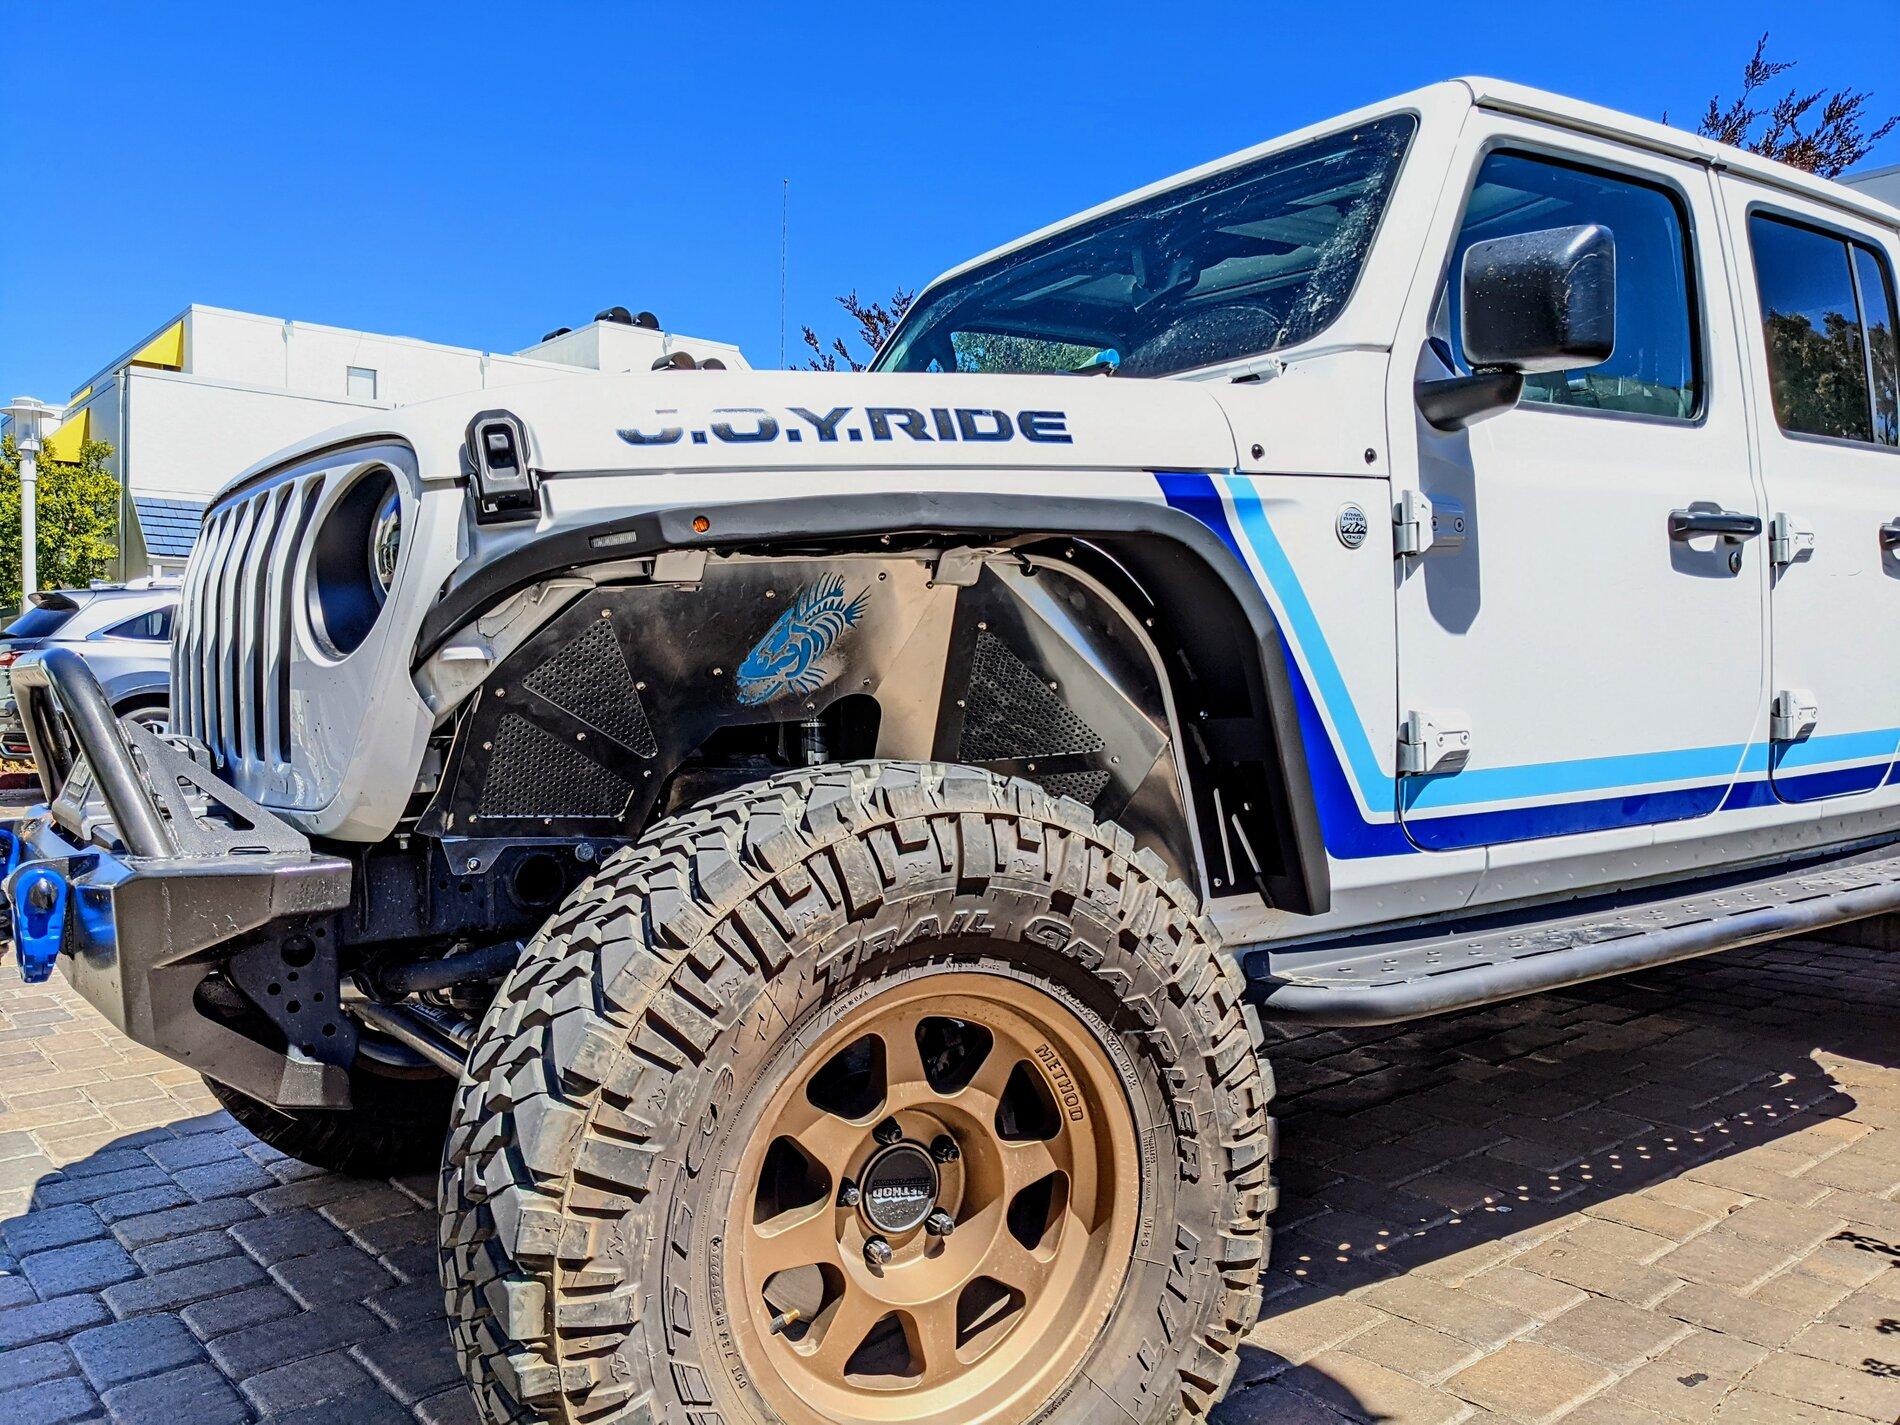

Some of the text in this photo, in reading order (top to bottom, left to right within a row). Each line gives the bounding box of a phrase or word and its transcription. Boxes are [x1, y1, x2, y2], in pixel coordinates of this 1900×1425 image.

[812, 909, 997, 987] TRAIL
[1023, 915, 1201, 1186] GRAPPLER
[1034, 1043, 1084, 1122] METHOD
[872, 1186, 930, 1199] METHOD
